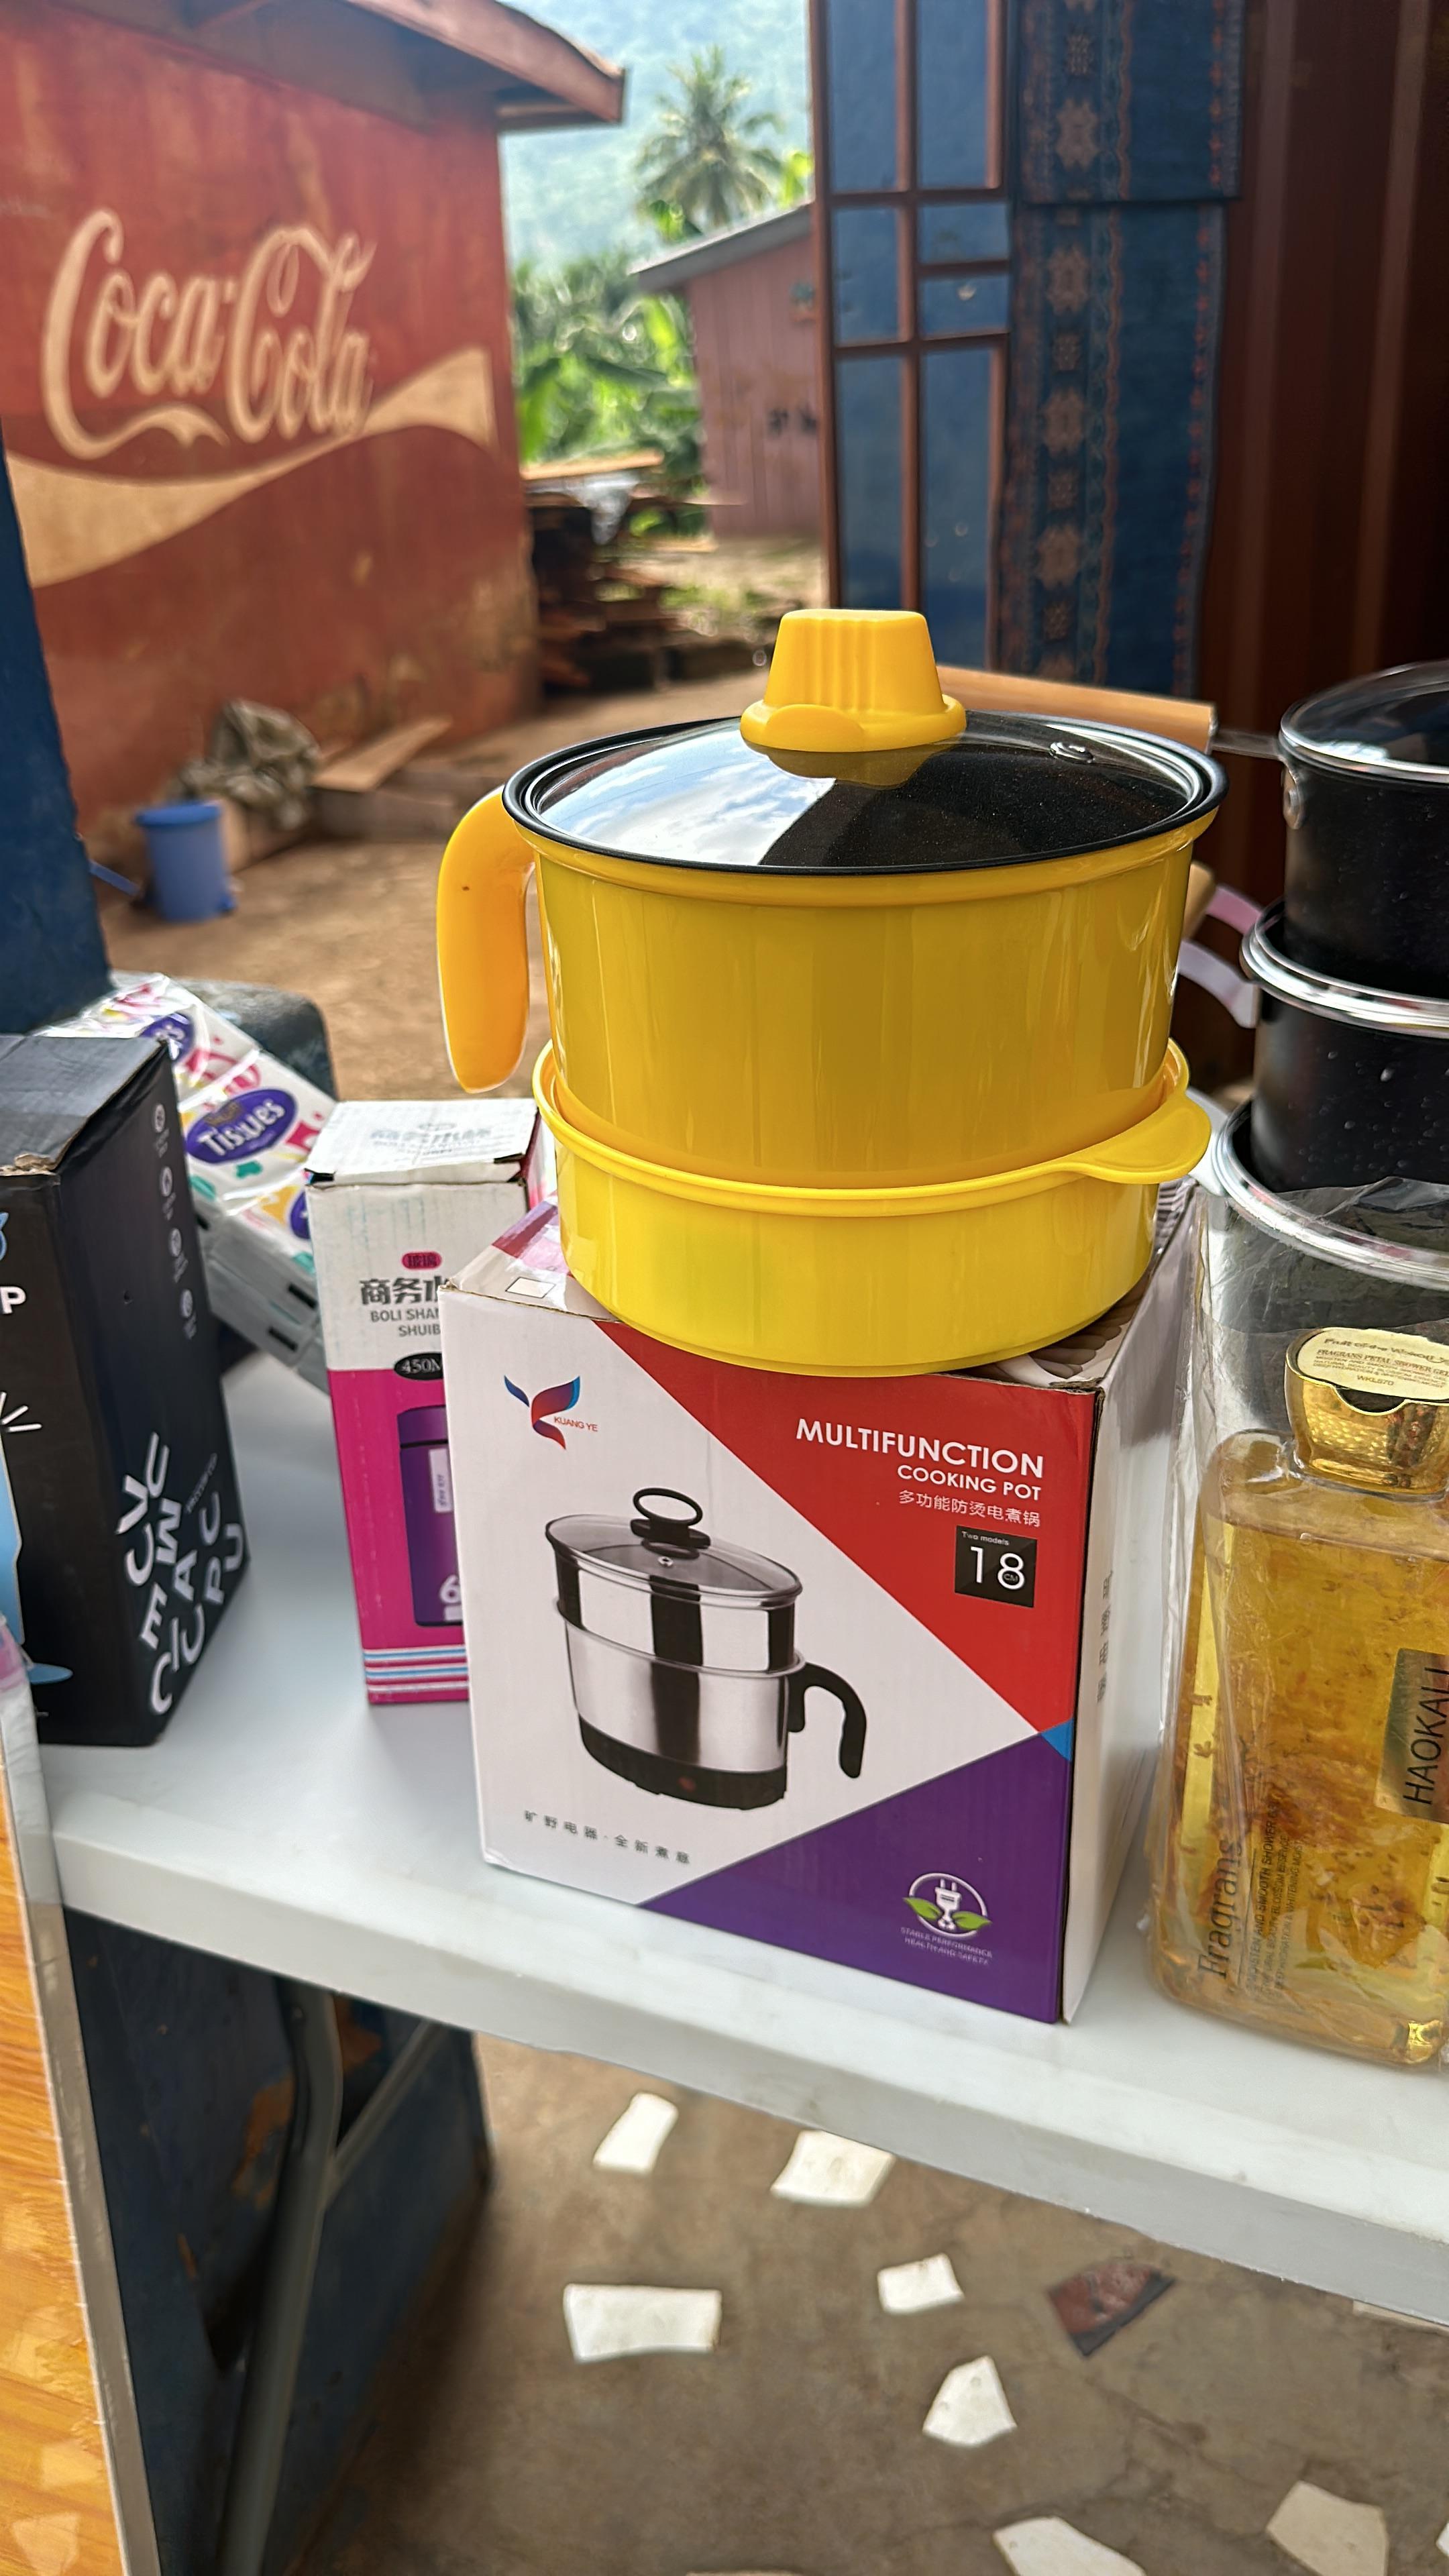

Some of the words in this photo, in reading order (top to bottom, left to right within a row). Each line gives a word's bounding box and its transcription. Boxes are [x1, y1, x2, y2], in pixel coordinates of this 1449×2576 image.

[370, 1310, 402, 1322] BOLI
[554, 1416, 584, 1430] KUANG
[586, 1423, 598, 1432] YE
[796, 1418, 1044, 1479] MULTIFUNCTION
[897, 1464, 997, 1493] COOKING
[1004, 1481, 1042, 1501] POT
[899, 1490, 1041, 1527] 多功能防烫电煮锅
[961, 1531, 979, 1540] Two
[980, 1536, 1010, 1546] models
[970, 1546, 1025, 1590] 18
[1261, 1821, 1276, 1865] SHOWER
[1256, 1867, 1270, 1911] SMOOTH
[1271, 1873, 1285, 1915] BLOSSOM
[1254, 1915, 1265, 1935] AND
